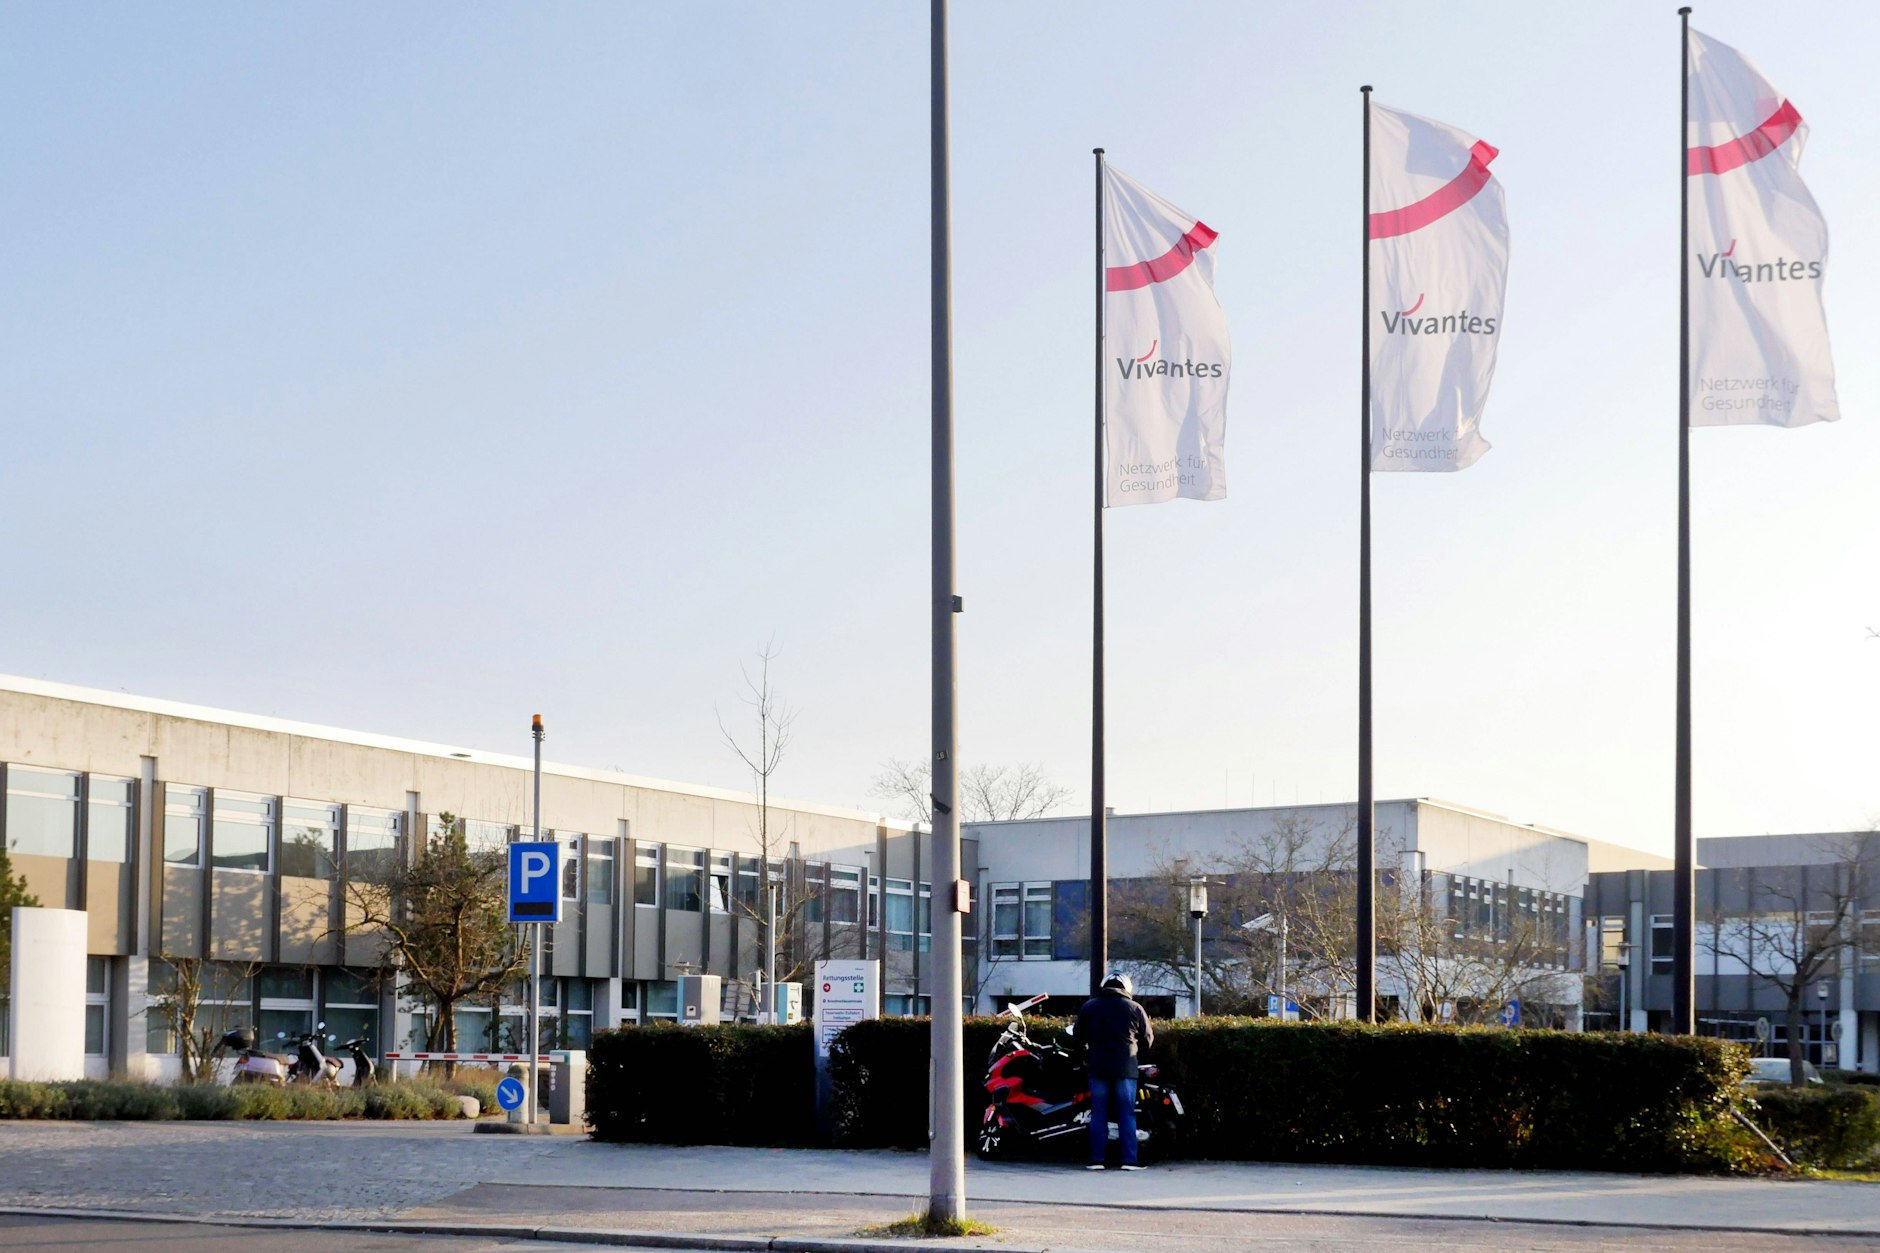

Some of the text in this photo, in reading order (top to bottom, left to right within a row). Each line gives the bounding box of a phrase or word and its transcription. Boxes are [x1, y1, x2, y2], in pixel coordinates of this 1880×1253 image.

[1697, 239, 1821, 283] Vivantes
[1381, 293, 1496, 335] Vivantes
[1116, 340, 1222, 379] Vivantes
[1700, 376, 1779, 393] Netzwerk
[1382, 427, 1450, 442] Netzwerk
[1119, 454, 1206, 477] Netzwerk für
[1119, 471, 1196, 493] Gesundheit
[521, 851, 551, 894] P
[822, 974, 864, 982] Rettungsstelle
